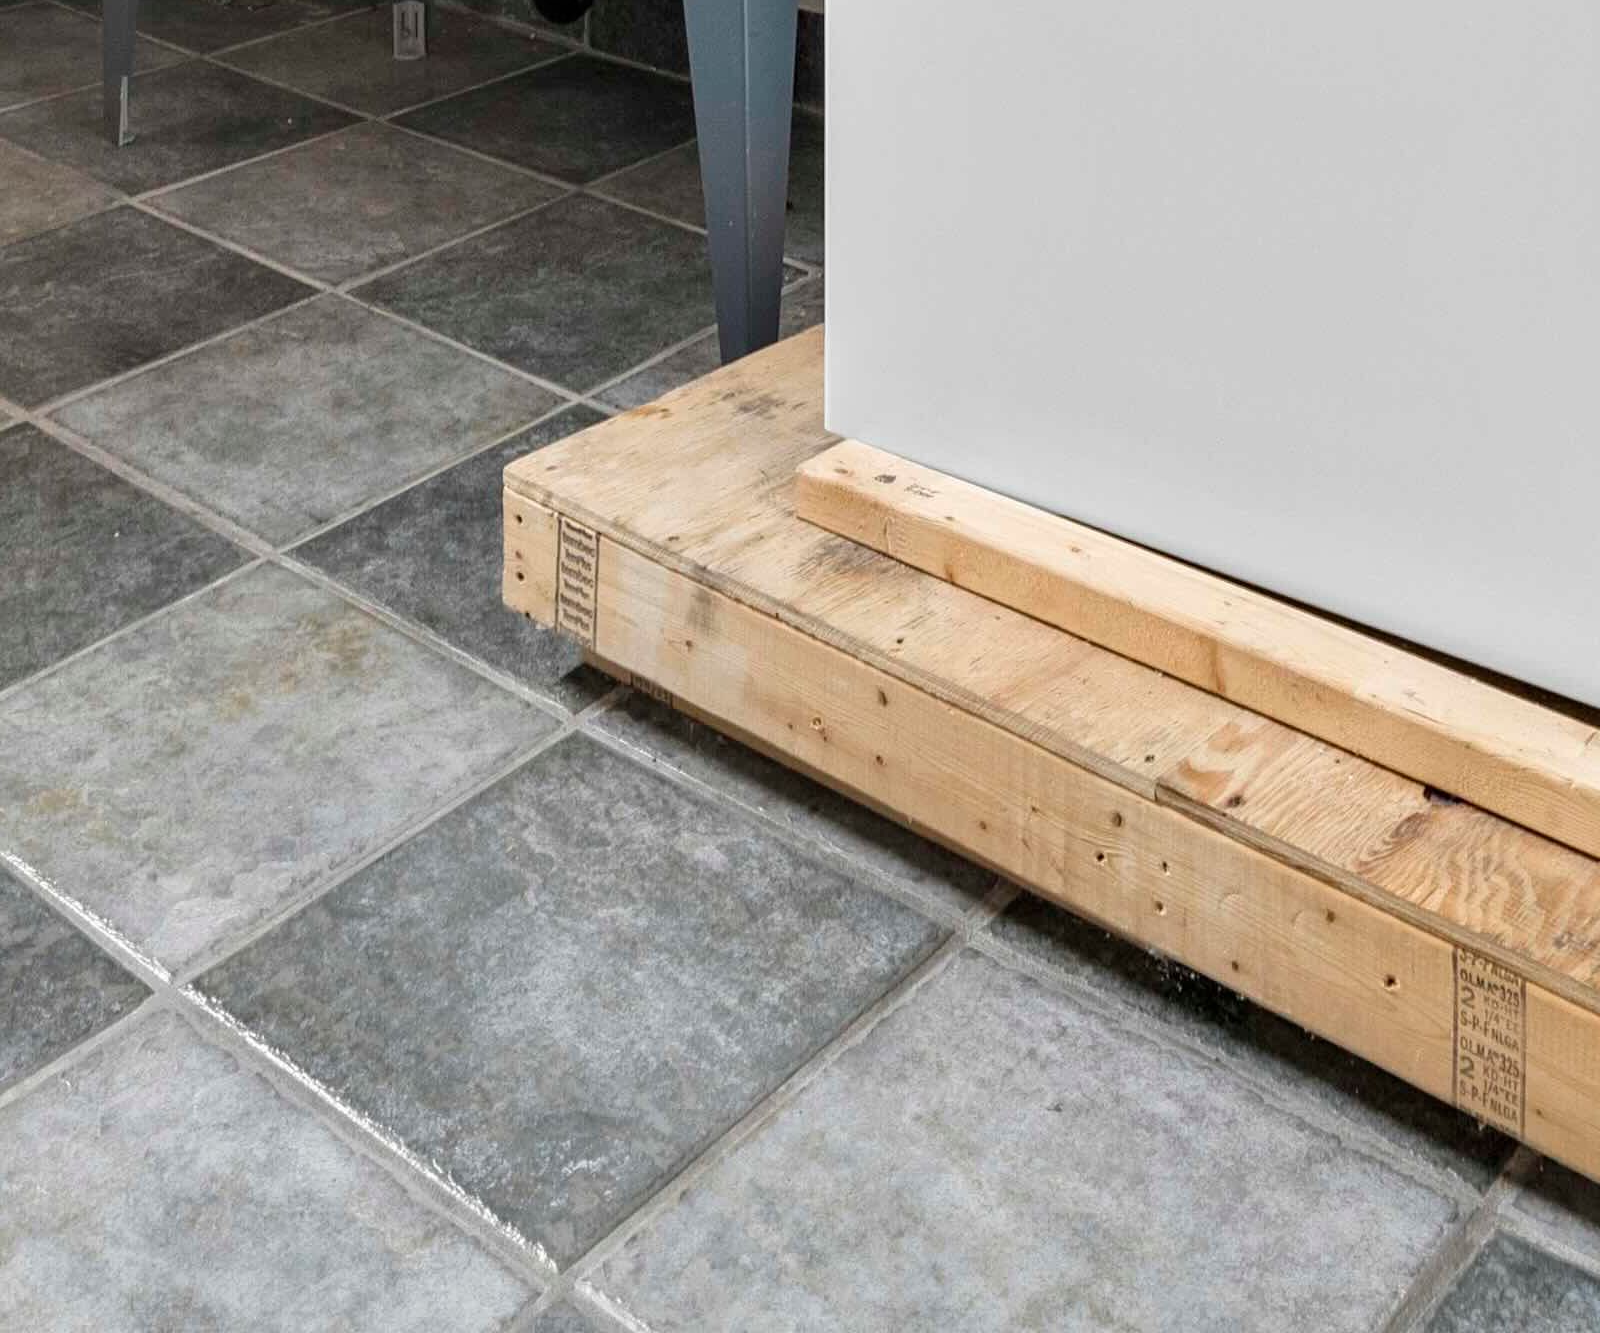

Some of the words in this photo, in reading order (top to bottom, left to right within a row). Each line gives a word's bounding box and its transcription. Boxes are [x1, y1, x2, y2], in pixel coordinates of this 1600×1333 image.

[1461, 986, 1475, 1010] 2
[1491, 1027, 1520, 1053] NLGA
[1460, 1056, 1475, 1080] 2
[1490, 1097, 1519, 1125] NLGA
